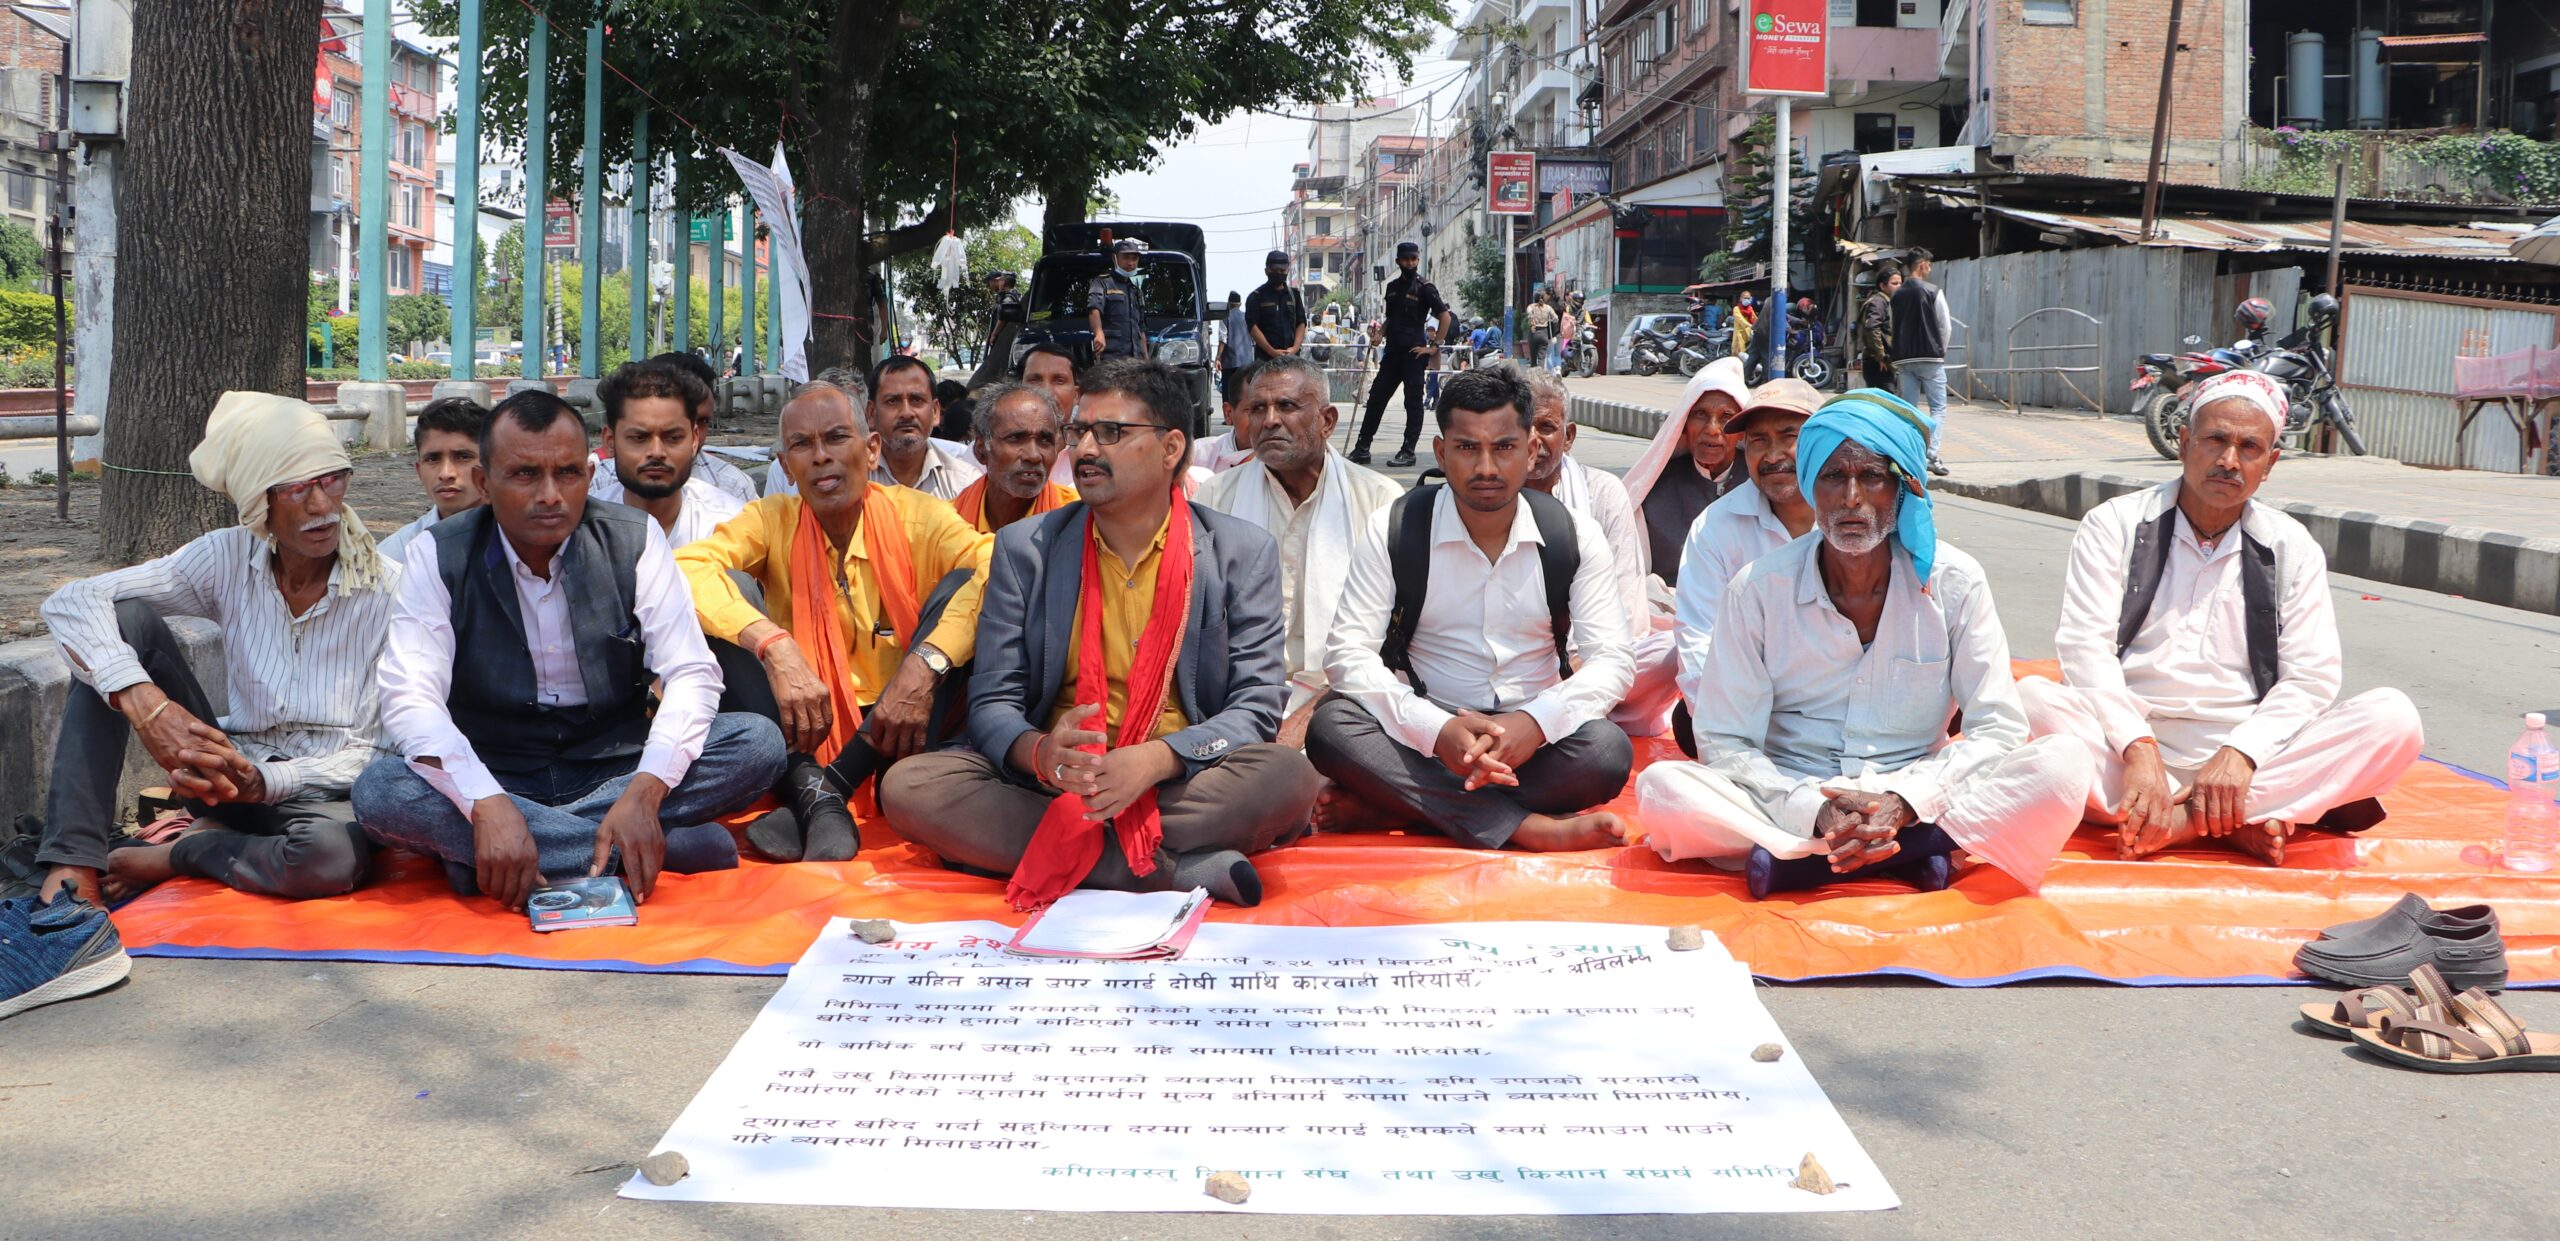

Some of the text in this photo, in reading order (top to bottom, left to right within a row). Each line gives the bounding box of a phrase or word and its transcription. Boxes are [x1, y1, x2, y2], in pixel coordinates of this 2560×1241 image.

[1541, 167, 1609, 181] TRANSLATION
[842, 974, 896, 987] ब्याज
[907, 971, 964, 986] सहित
[977, 976, 1033, 991] असुल
[1045, 978, 1092, 988] उपर
[1103, 973, 1156, 991] गराई
[1168, 969, 1222, 990] दोषी
[1228, 969, 1280, 990] माथि
[1292, 972, 1379, 991] कारवाही
[824, 999, 905, 1010] विभिन्न
[914, 1001, 996, 1012] समयमा
[1008, 1005, 1101, 1013] सरकारले
[1116, 1003, 1193, 1016] तोकेको
[1511, 1006, 1552, 1016] कम
[1566, 1008, 1637, 1017] मुल्यमा
[816, 1013, 873, 1024] खरिद
[886, 1014, 947, 1024] गरेको
[960, 1016, 1022, 1026] हुनाले
[1035, 1017, 1134, 1030] काटिएको
[1147, 1017, 1202, 1027] रकम
[1212, 1017, 1272, 1028] समेत
[1285, 1021, 1368, 1031] उपलब्ध
[798, 1039, 824, 1048] यो
[838, 1040, 915, 1050] आर्थिक
[982, 1043, 1051, 1054] उखुको
[1070, 1046, 1117, 1056] मुल्य
[1134, 1044, 1175, 1055] यहि
[1289, 1046, 1378, 1056] निर्धारण
[778, 1068, 816, 1078] सबै
[833, 1072, 872, 1082] उखु
[889, 1070, 1016, 1082] किसानलाई
[1033, 1074, 1148, 1085] अनुदानको
[1490, 1074, 1583, 1085] उपजको
[1599, 1073, 1700, 1084] सरकारले
[765, 1083, 858, 1095] निर्धारण
[875, 1086, 940, 1096] गरेको
[1064, 1088, 1144, 1100] समर्थन
[1162, 1092, 1215, 1103] मुल्य
[1233, 1090, 1327, 1101] अनिवार्य
[1343, 1091, 1408, 1102] रुपमा
[1423, 1090, 1491, 1102] पाउने
[1506, 1093, 1599, 1101] व्यवस्था
[854, 1118, 919, 1130] खरिद
[936, 1119, 982, 1131] गर्दा
[999, 1121, 1112, 1135] सहुलियत
[1128, 1125, 1192, 1134] दरमा
[1208, 1126, 1288, 1134] भन्सार
[1304, 1123, 1367, 1136] गराई
[1384, 1123, 1477, 1138] कृषकले
[1564, 1126, 1648, 1134] ल्याउन
[1664, 1122, 1733, 1134] पाउने
[732, 1133, 777, 1144] गरि
[791, 1136, 888, 1146] व्यवस्था
[1303, 1168, 1350, 1179] संघ
[1382, 1171, 1435, 1180] तथा
[1451, 1167, 1507, 1183] उखु
[1515, 1167, 1607, 1181] किसान
[1623, 1166, 1691, 1179] संघर्ष
[1711, 1165, 1798, 1179] समिति
